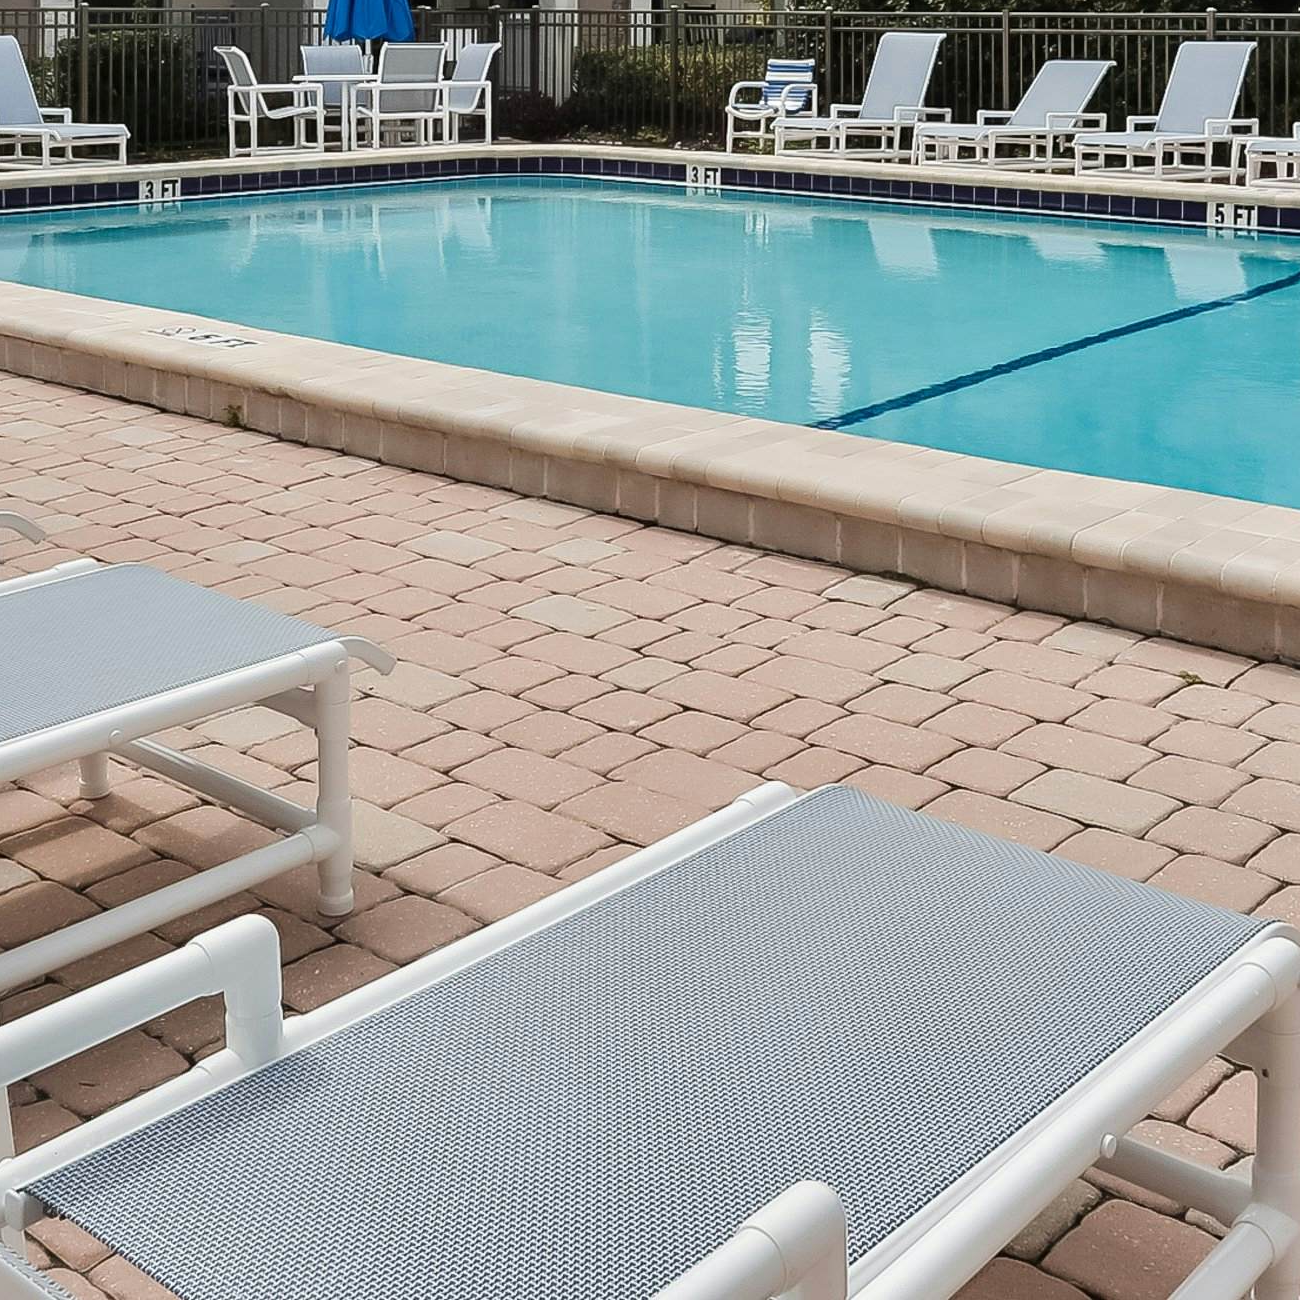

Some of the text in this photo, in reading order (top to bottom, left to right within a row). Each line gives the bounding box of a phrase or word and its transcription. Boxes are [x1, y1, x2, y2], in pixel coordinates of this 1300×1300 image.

[691, 166, 719, 185] 3 FT
[145, 179, 179, 199] 3 FT
[1215, 203, 1256, 226] 5 FT
